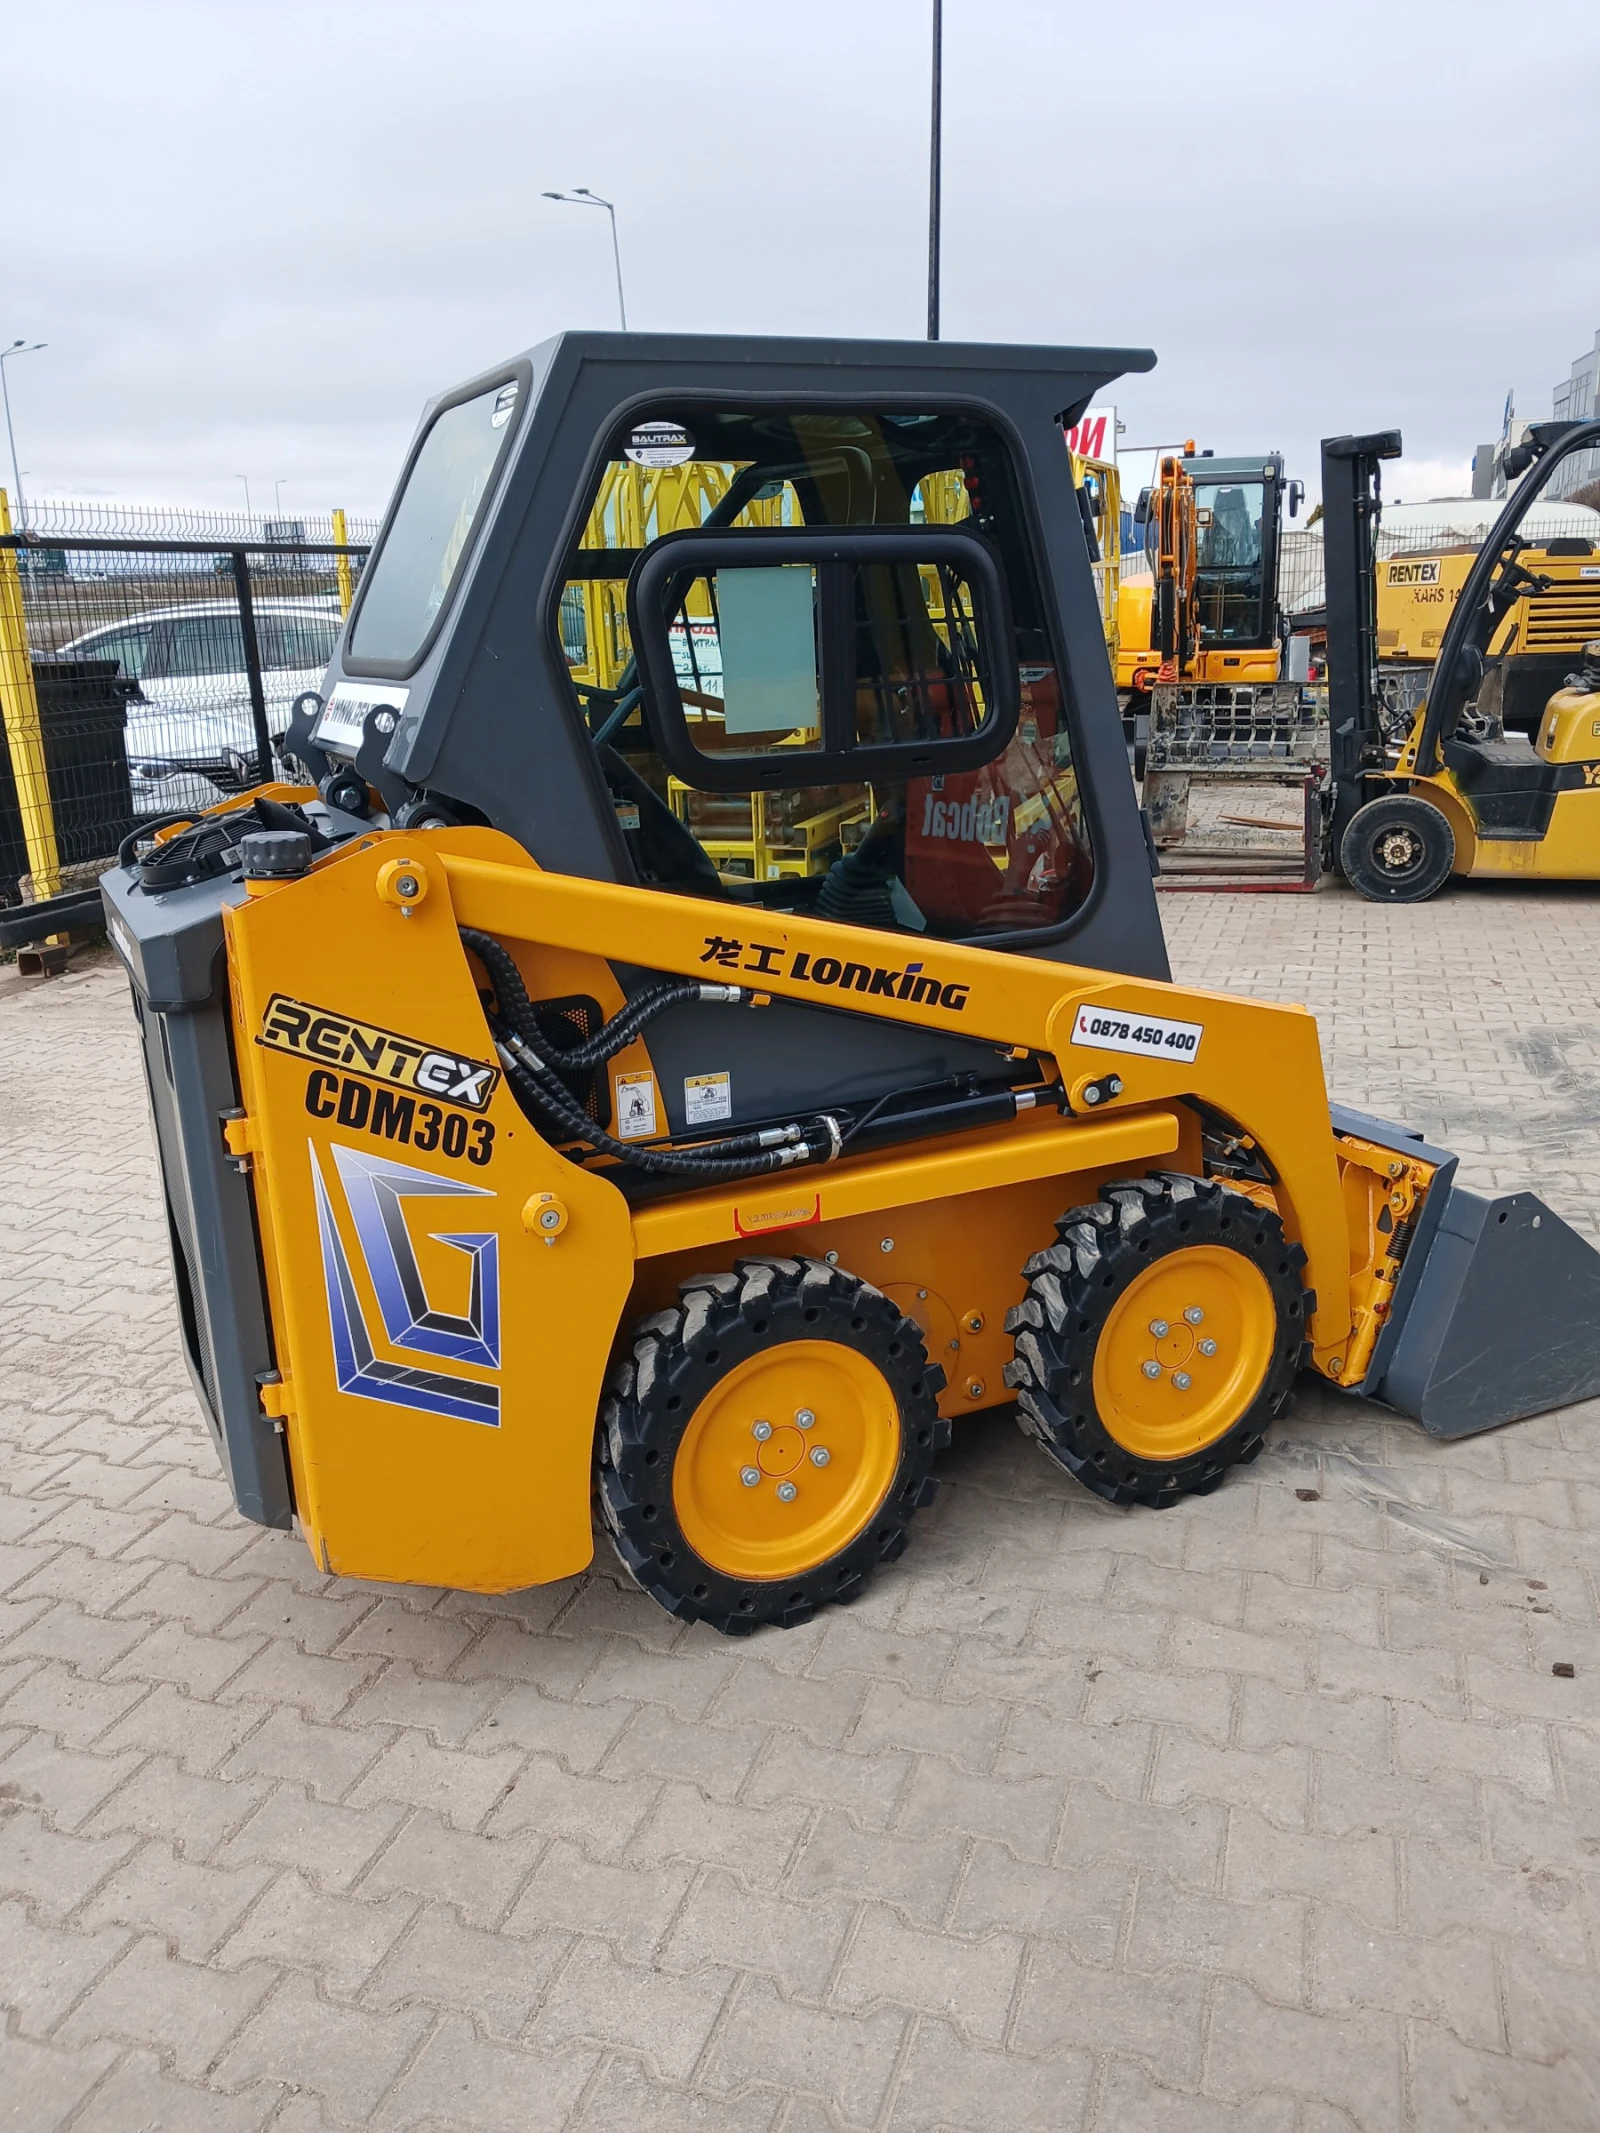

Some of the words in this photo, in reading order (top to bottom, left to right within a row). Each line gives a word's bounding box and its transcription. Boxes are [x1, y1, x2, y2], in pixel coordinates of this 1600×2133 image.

[631, 434, 687, 443] BAUTRAX
[1389, 563, 1438, 583] RENTEX
[1413, 588, 1445, 603] XAHS
[700, 936, 785, 976] 龙工
[1090, 1018, 1130, 1040] 0878
[1131, 1026, 1164, 1046] 450
[1164, 1031, 1196, 1051] 400
[265, 1002, 492, 1104] RENTEX
[305, 1070, 496, 1167] CDM303
